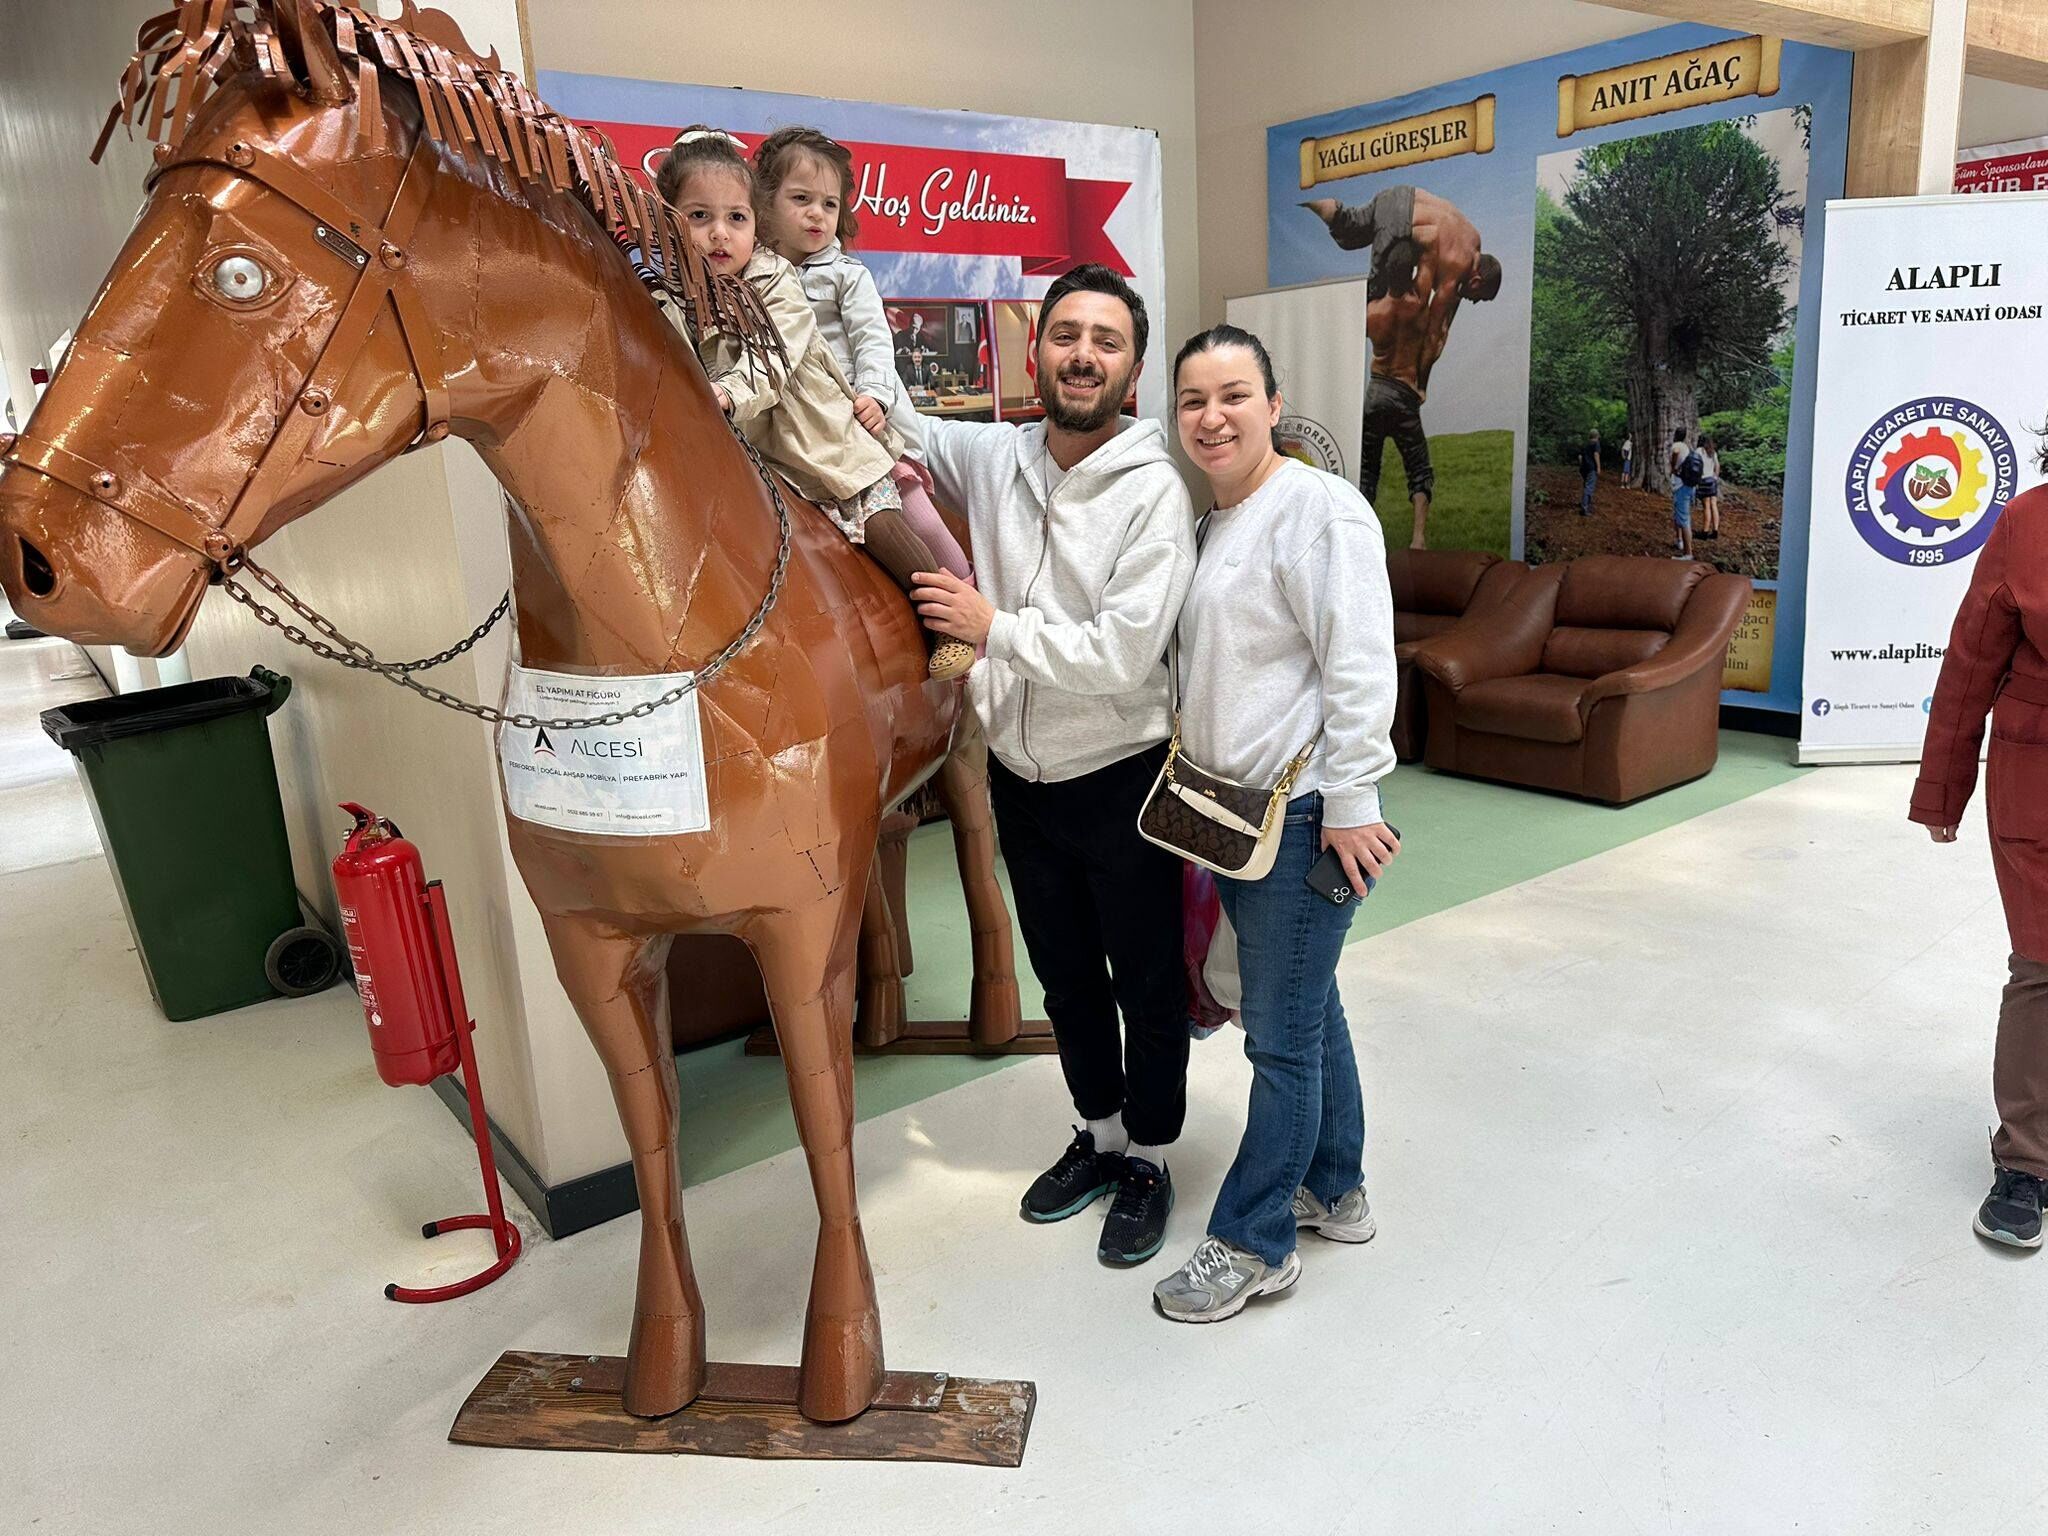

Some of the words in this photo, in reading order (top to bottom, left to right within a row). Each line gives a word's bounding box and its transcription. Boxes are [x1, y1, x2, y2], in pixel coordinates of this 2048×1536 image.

[1590, 74, 1657, 112] ANIT
[1663, 56, 1741, 96] AĞAÇ
[1318, 141, 1365, 169] YAĞLI
[1370, 120, 1468, 153] GÜREŞLER
[850, 162, 911, 228] Hoş
[920, 166, 1037, 236] Geldiniz.
[1885, 263, 2002, 291] ALAPLI
[1840, 308, 1907, 326] TİCARET
[1911, 310, 1931, 324] VE
[1934, 303, 1990, 323] SANAYİ
[1995, 305, 2043, 321] ODASI
[1851, 454, 1872, 512] ALAPLI
[1863, 403, 1927, 451] TİCARET
[1931, 402, 1955, 417] VE
[1956, 406, 2009, 453] SANAYİ
[1993, 453, 2012, 507] ODASI
[1908, 549, 1944, 564] 1995
[1740, 612, 1769, 626] ğacı
[536, 685, 545, 693] EL
[546, 686, 574, 696] YAPIMI
[575, 690, 585, 698] AT
[571, 737, 643, 758] ALCESİ
[540, 766, 562, 777] DOĞAL
[562, 771, 585, 780] AHŞAP
[586, 773, 617, 782] MOBİLYA
[623, 772, 669, 782] PREFABRİK
[669, 771, 688, 780] YAPI
